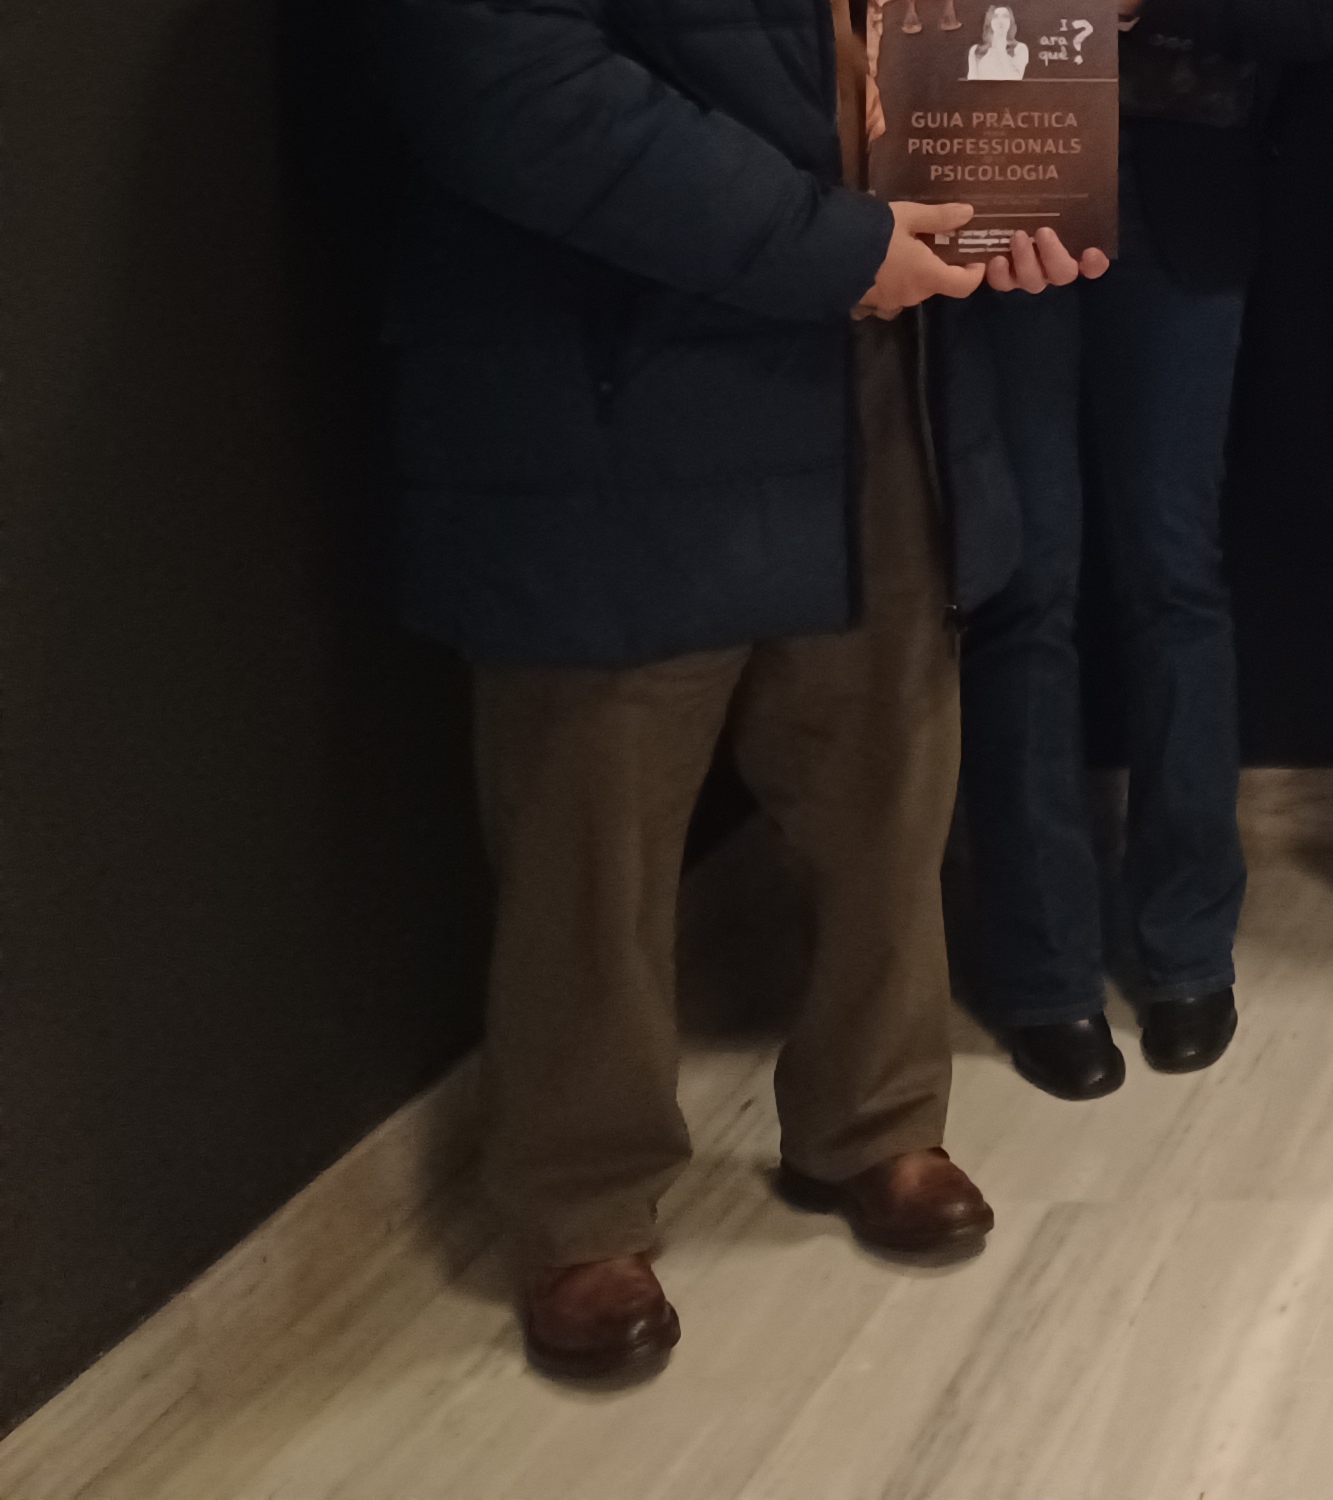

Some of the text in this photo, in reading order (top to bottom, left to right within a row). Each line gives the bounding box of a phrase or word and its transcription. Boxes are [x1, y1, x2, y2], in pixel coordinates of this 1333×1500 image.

[1040, 36, 1068, 45] ara
[911, 107, 1078, 129] GUIA PRÀCTICA
[907, 137, 1082, 155] PROFESSIONALS
[930, 164, 1059, 182] PSICOLOGIA
